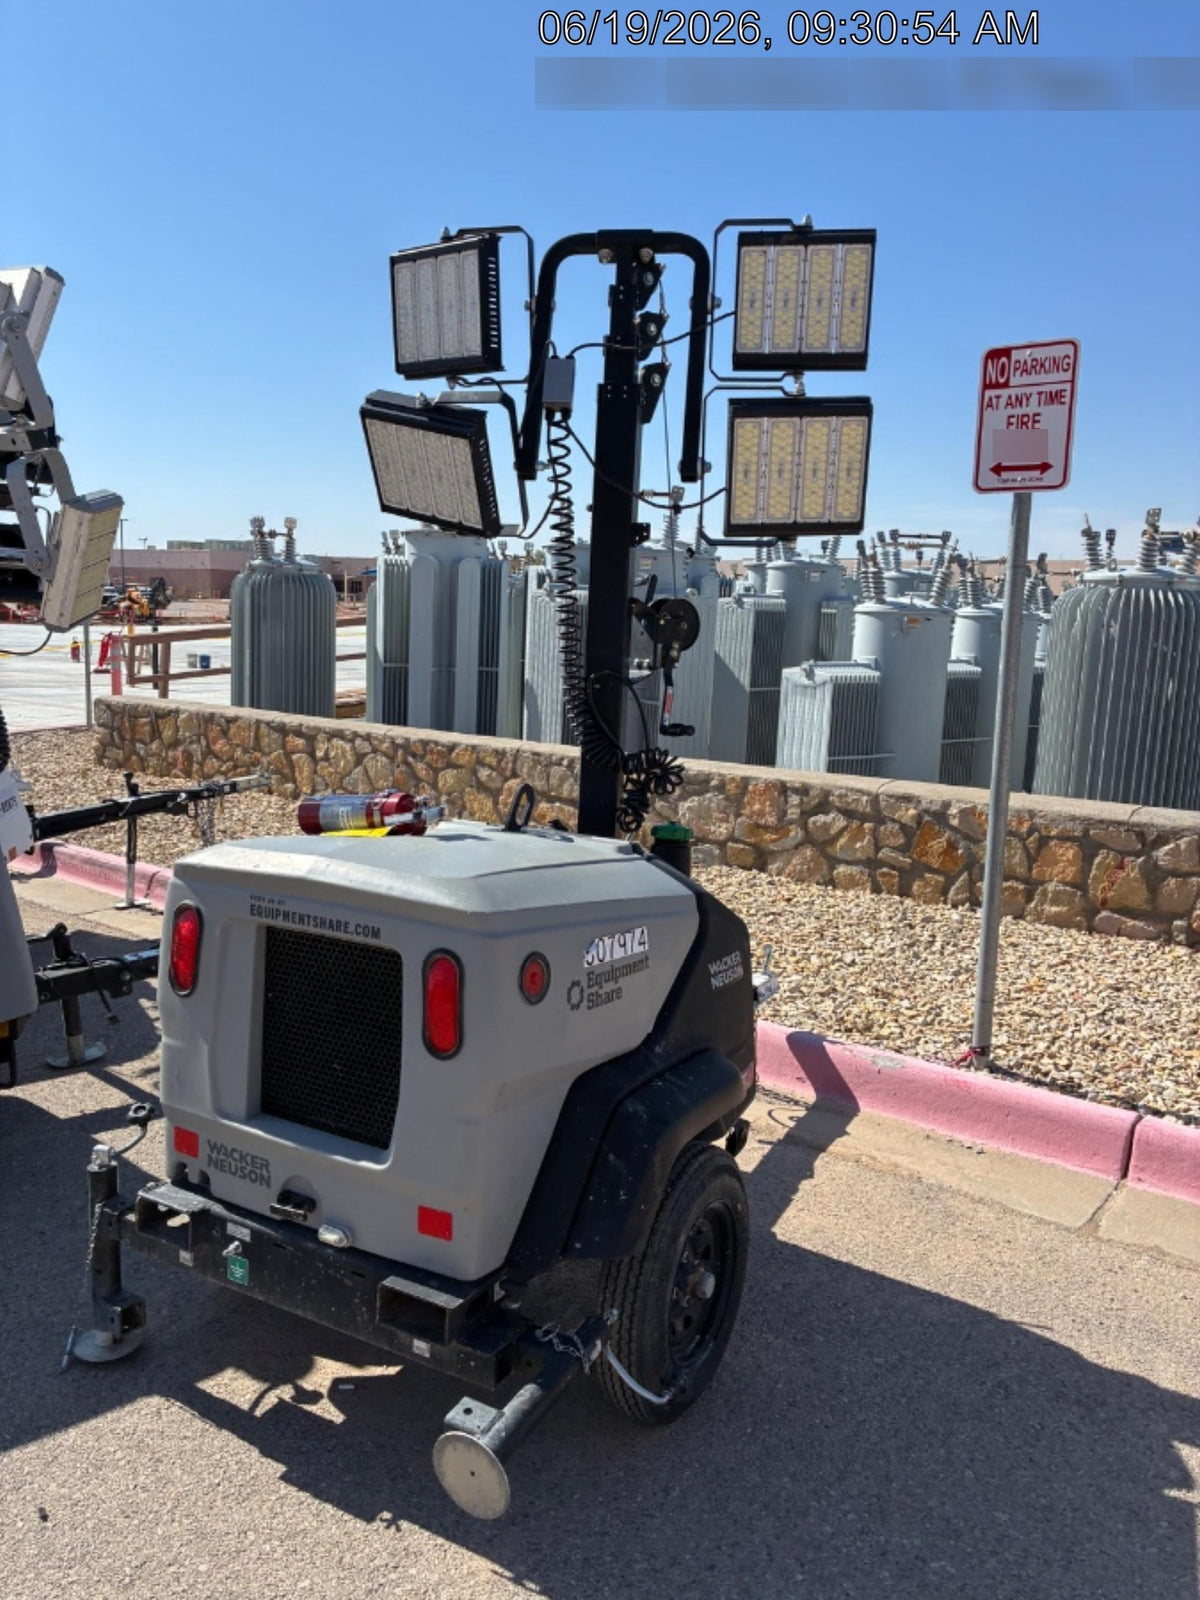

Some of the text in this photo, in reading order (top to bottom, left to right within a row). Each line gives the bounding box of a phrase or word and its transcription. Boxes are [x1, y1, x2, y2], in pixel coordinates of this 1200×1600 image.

[986, 354, 1071, 385] NO PARKING
[985, 389, 1068, 411] AT ANY TIME
[1006, 412, 1042, 429] FIRE
[249, 904, 381, 940] EQUIPMENTSHARE.COM
[586, 954, 649, 989] Equipment
[707, 951, 742, 975] WACKER
[710, 966, 744, 990] NEUSON
[586, 986, 623, 1010] Share
[207, 1139, 271, 1174] WACKER
[207, 1154, 271, 1189] NEUSON
